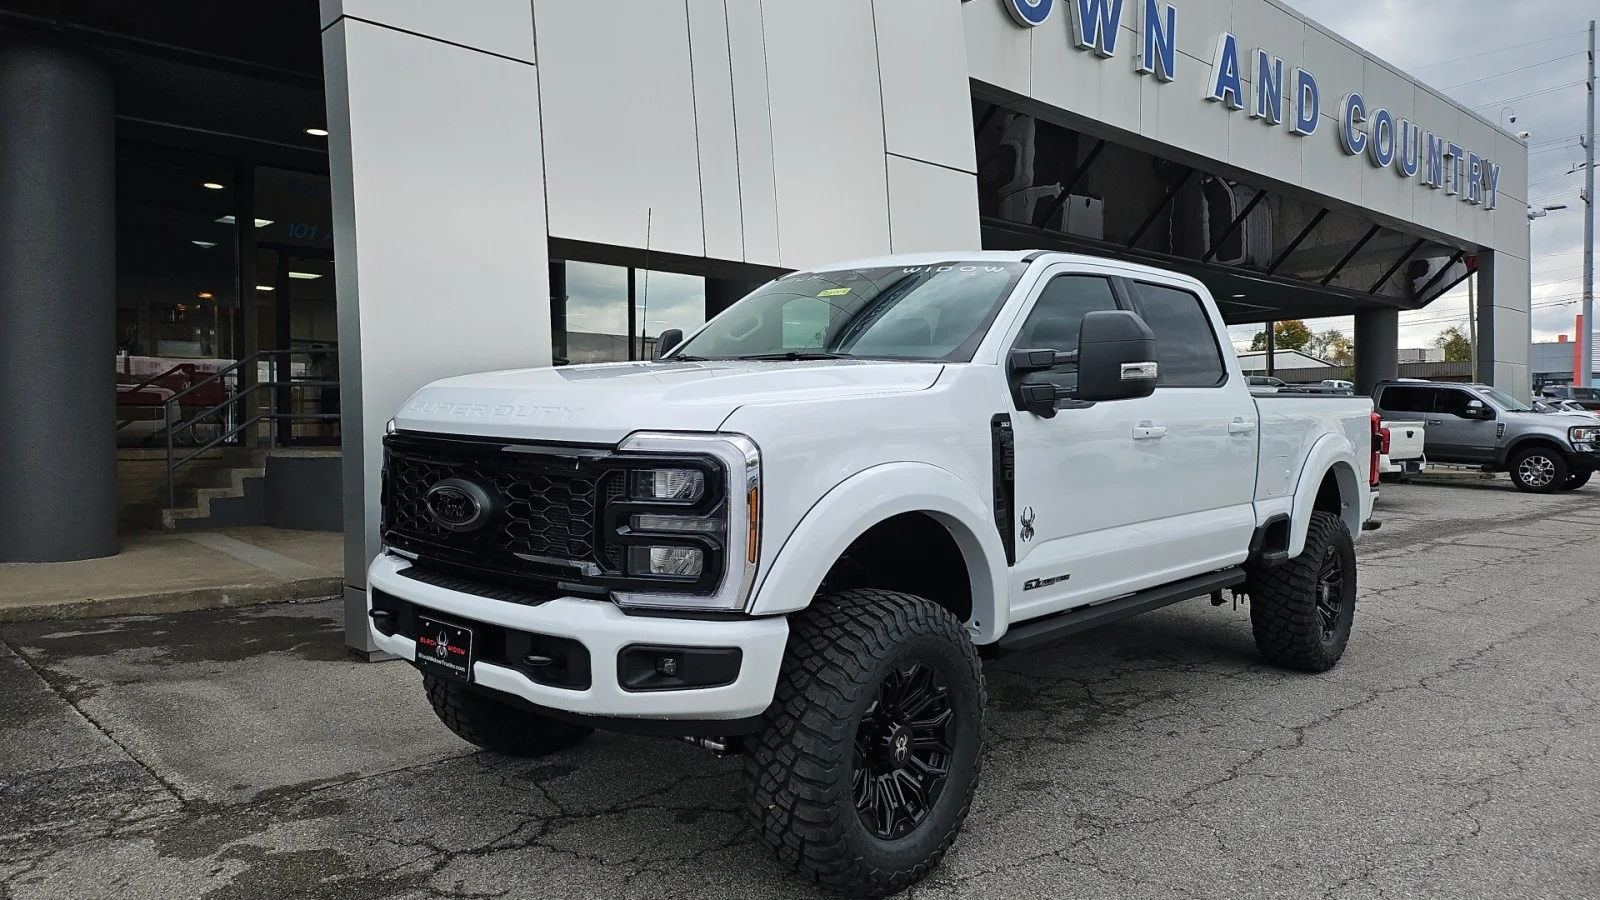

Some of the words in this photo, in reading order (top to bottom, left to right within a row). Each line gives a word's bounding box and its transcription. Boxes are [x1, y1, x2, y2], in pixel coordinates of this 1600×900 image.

[1208, 31, 1320, 136] AND
[1339, 92, 1500, 210] COUNTRY
[903, 265, 1005, 274] WIDOW
[408, 401, 488, 417] SUPER
[490, 404, 585, 421] DUTY
[420, 637, 437, 646] BLACK
[448, 646, 466, 655] WIDOW
